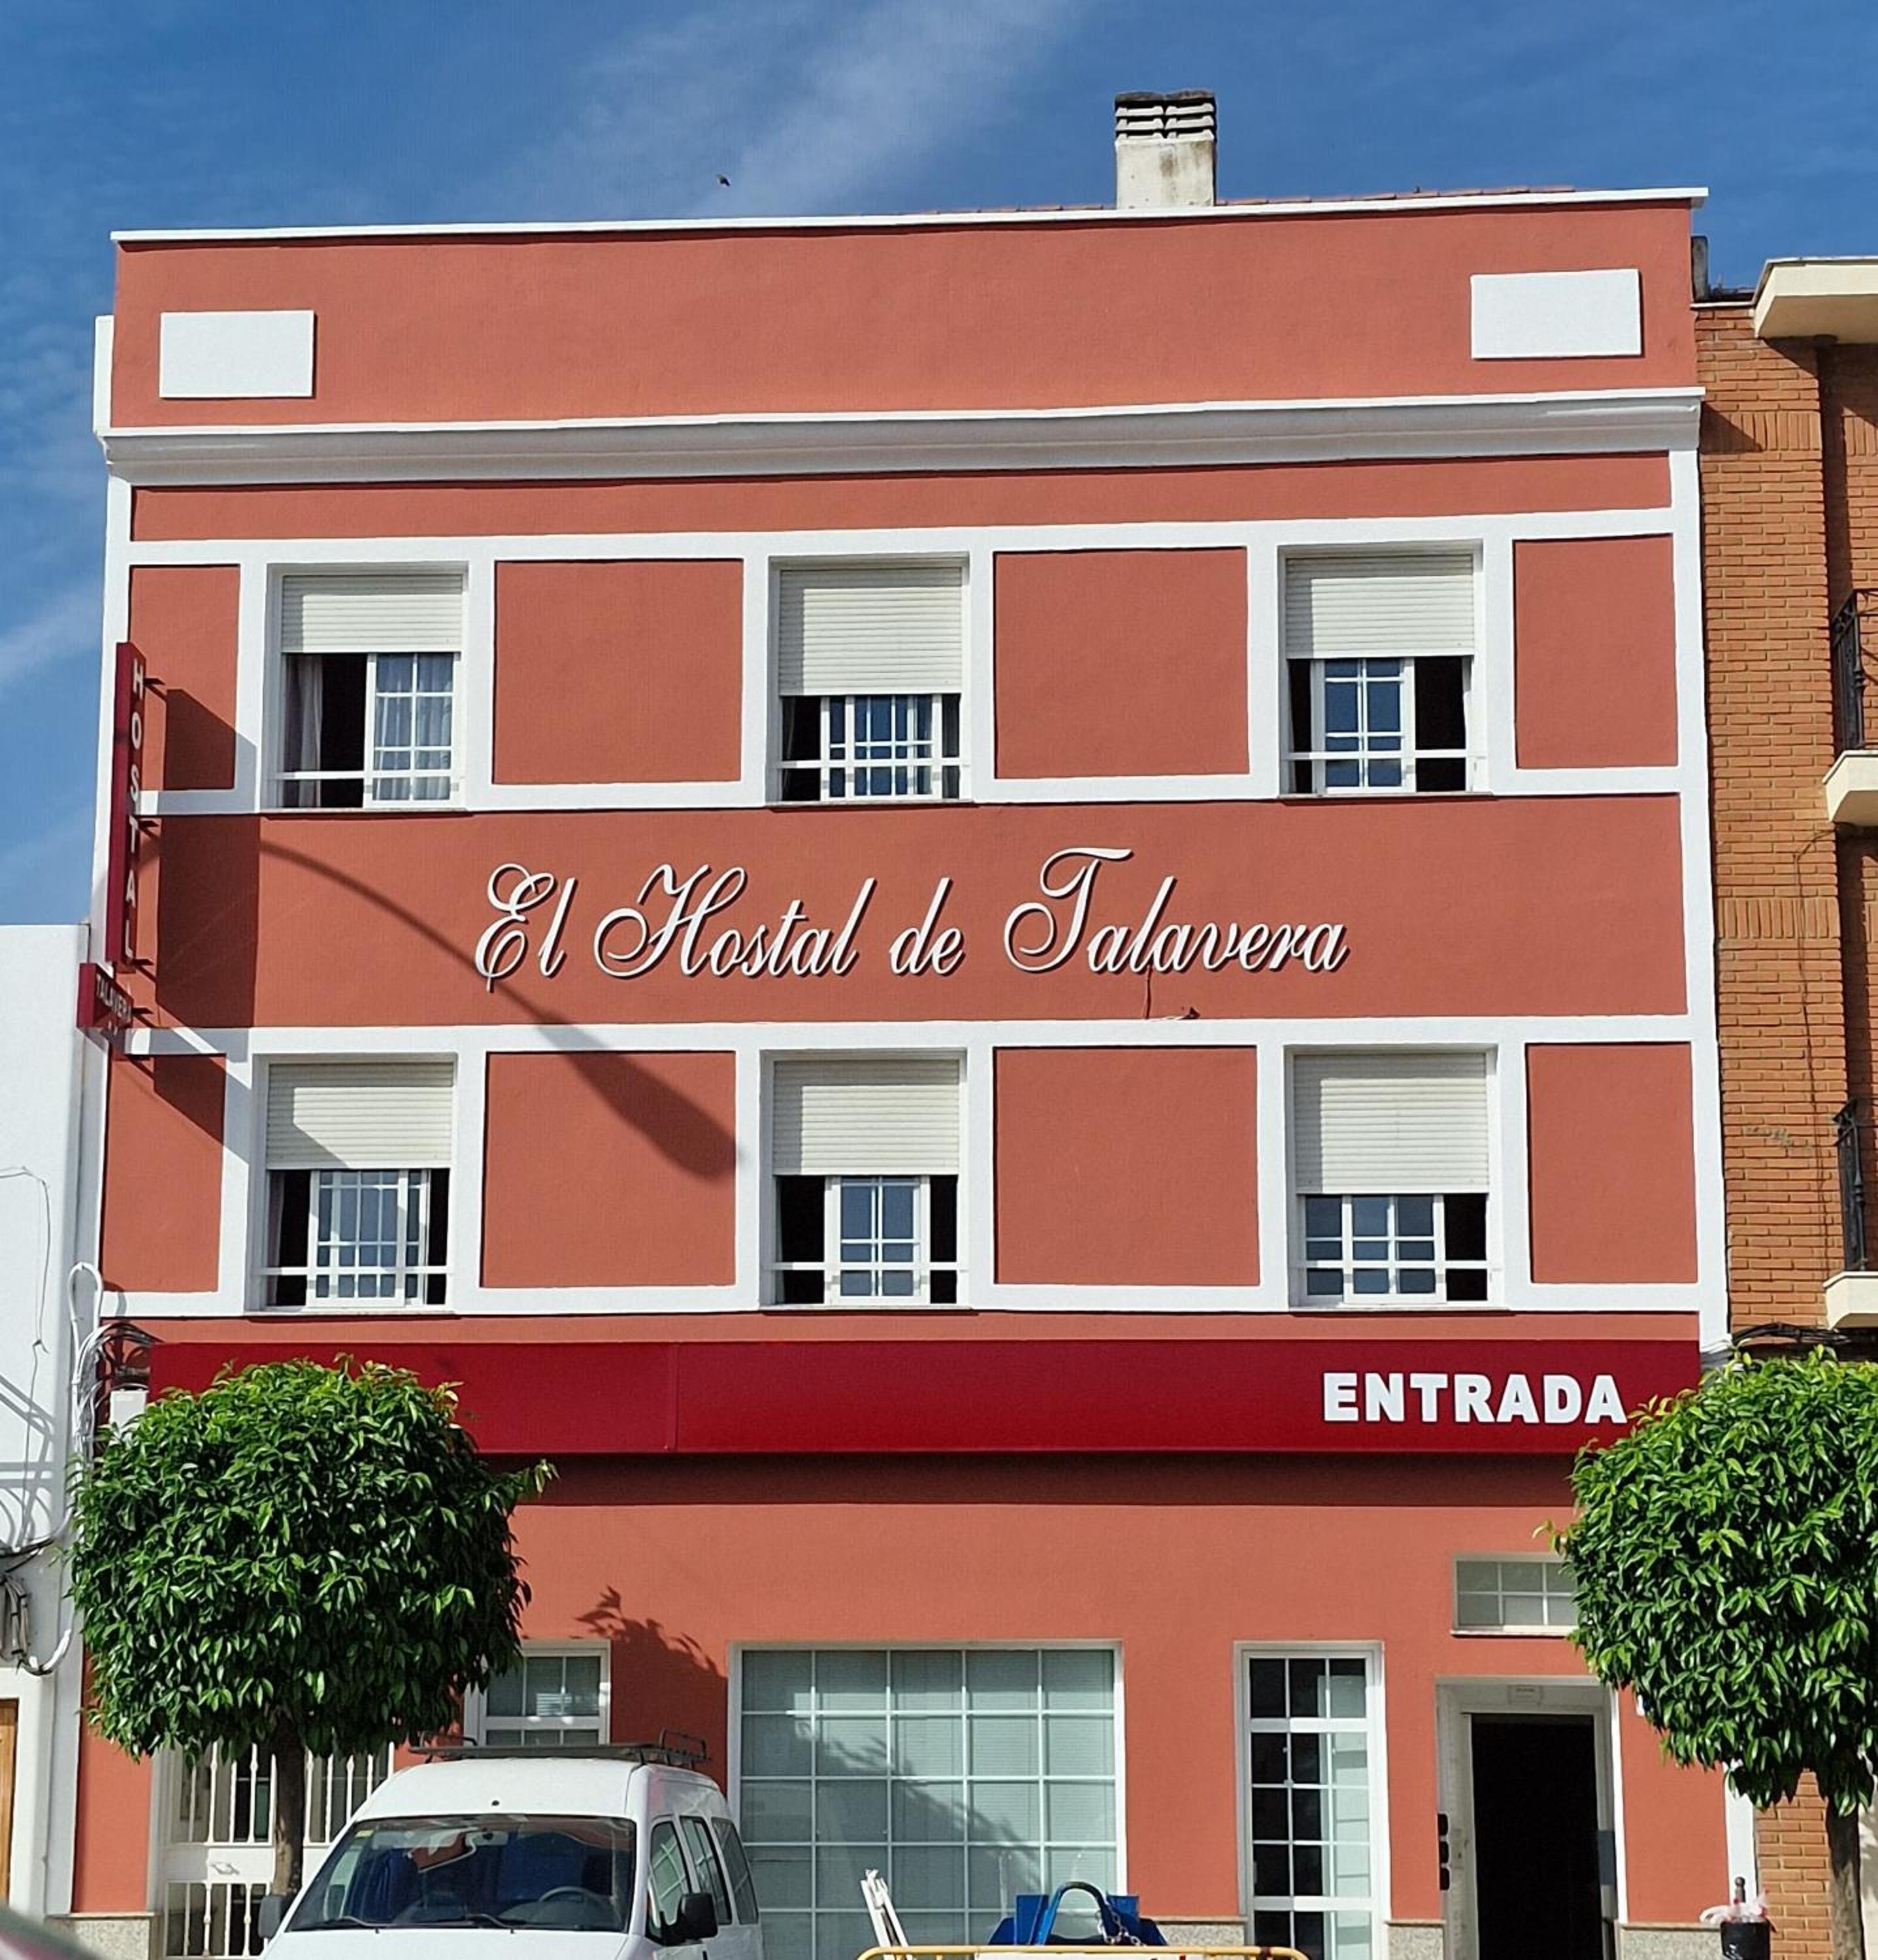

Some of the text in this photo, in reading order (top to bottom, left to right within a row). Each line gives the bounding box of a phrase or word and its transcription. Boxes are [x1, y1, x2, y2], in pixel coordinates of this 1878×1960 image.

[125, 659, 143, 959] HOSTAL
[474, 847, 1349, 992] El Hostal de Talavera
[1323, 1373, 1628, 1424] ENTRADA
